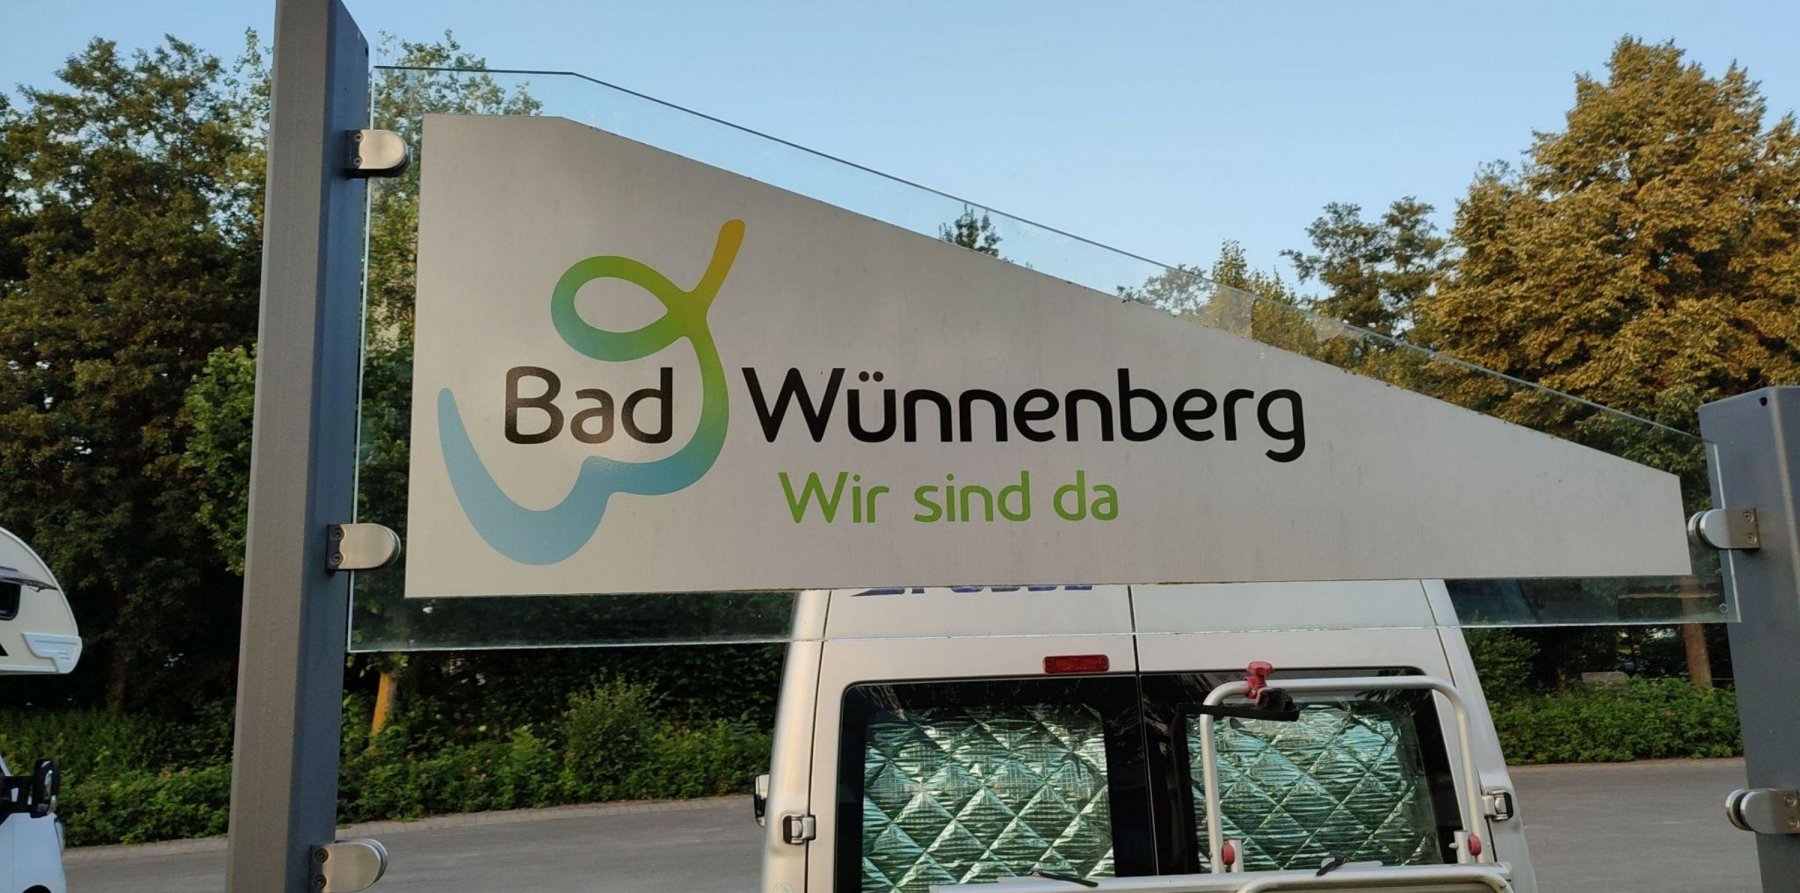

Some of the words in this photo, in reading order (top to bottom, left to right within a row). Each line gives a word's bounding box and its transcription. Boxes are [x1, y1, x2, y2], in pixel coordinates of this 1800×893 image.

[504, 366, 674, 445] Bad
[741, 367, 1306, 463] Wünnenberg
[778, 470, 891, 525] Wir
[913, 469, 1032, 523] sind
[1052, 469, 1120, 523] da
